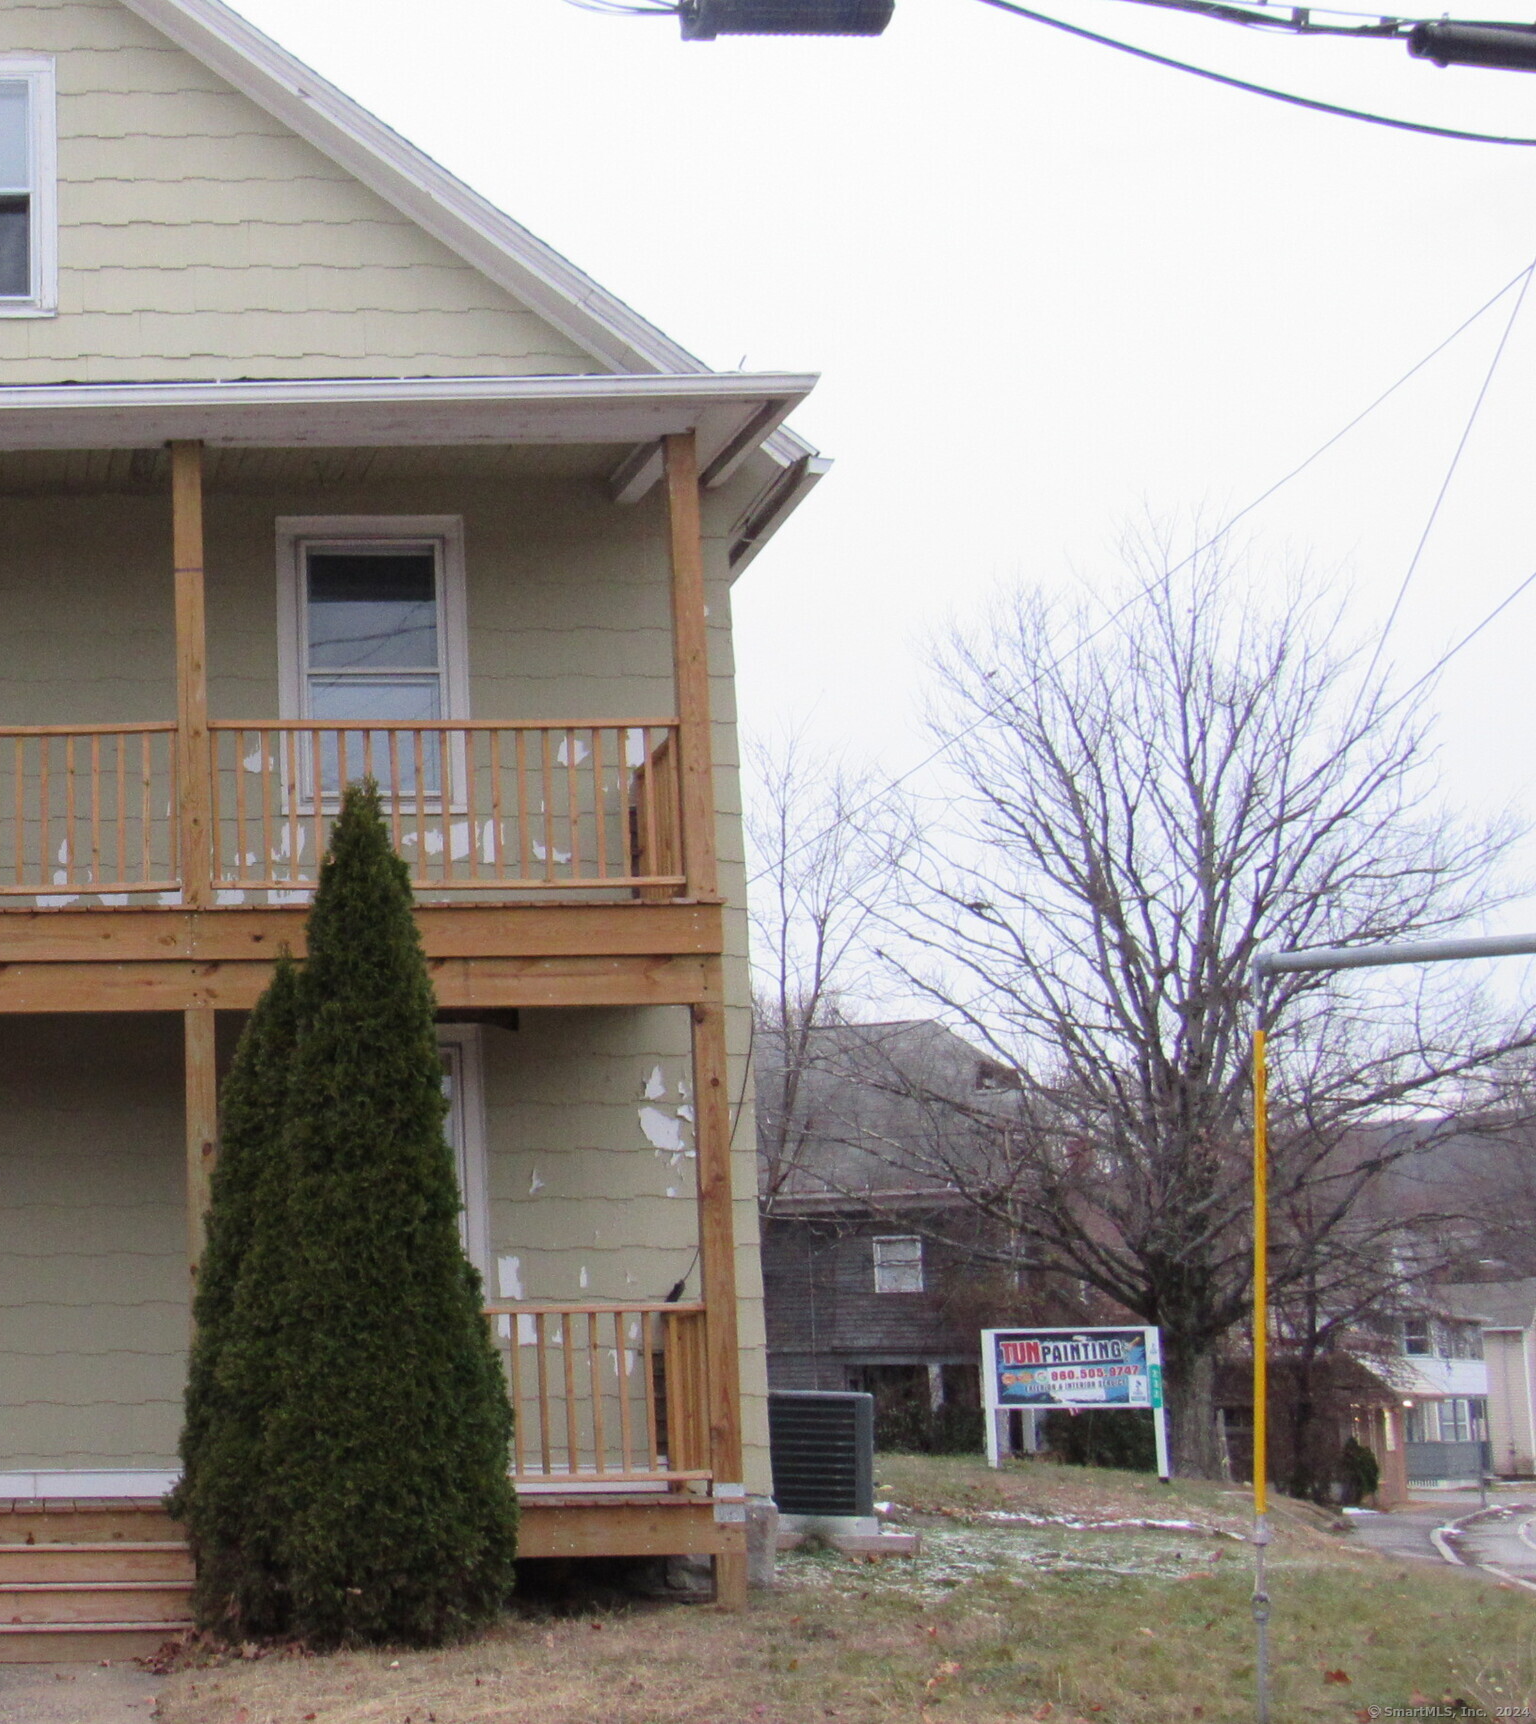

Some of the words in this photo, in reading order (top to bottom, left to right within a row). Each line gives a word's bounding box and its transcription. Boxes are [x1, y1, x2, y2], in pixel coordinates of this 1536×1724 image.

[1000, 1341, 1040, 1365] TUN
[1042, 1341, 1122, 1363] PAINTING
[1065, 1381, 1096, 1390] INTERIOR
